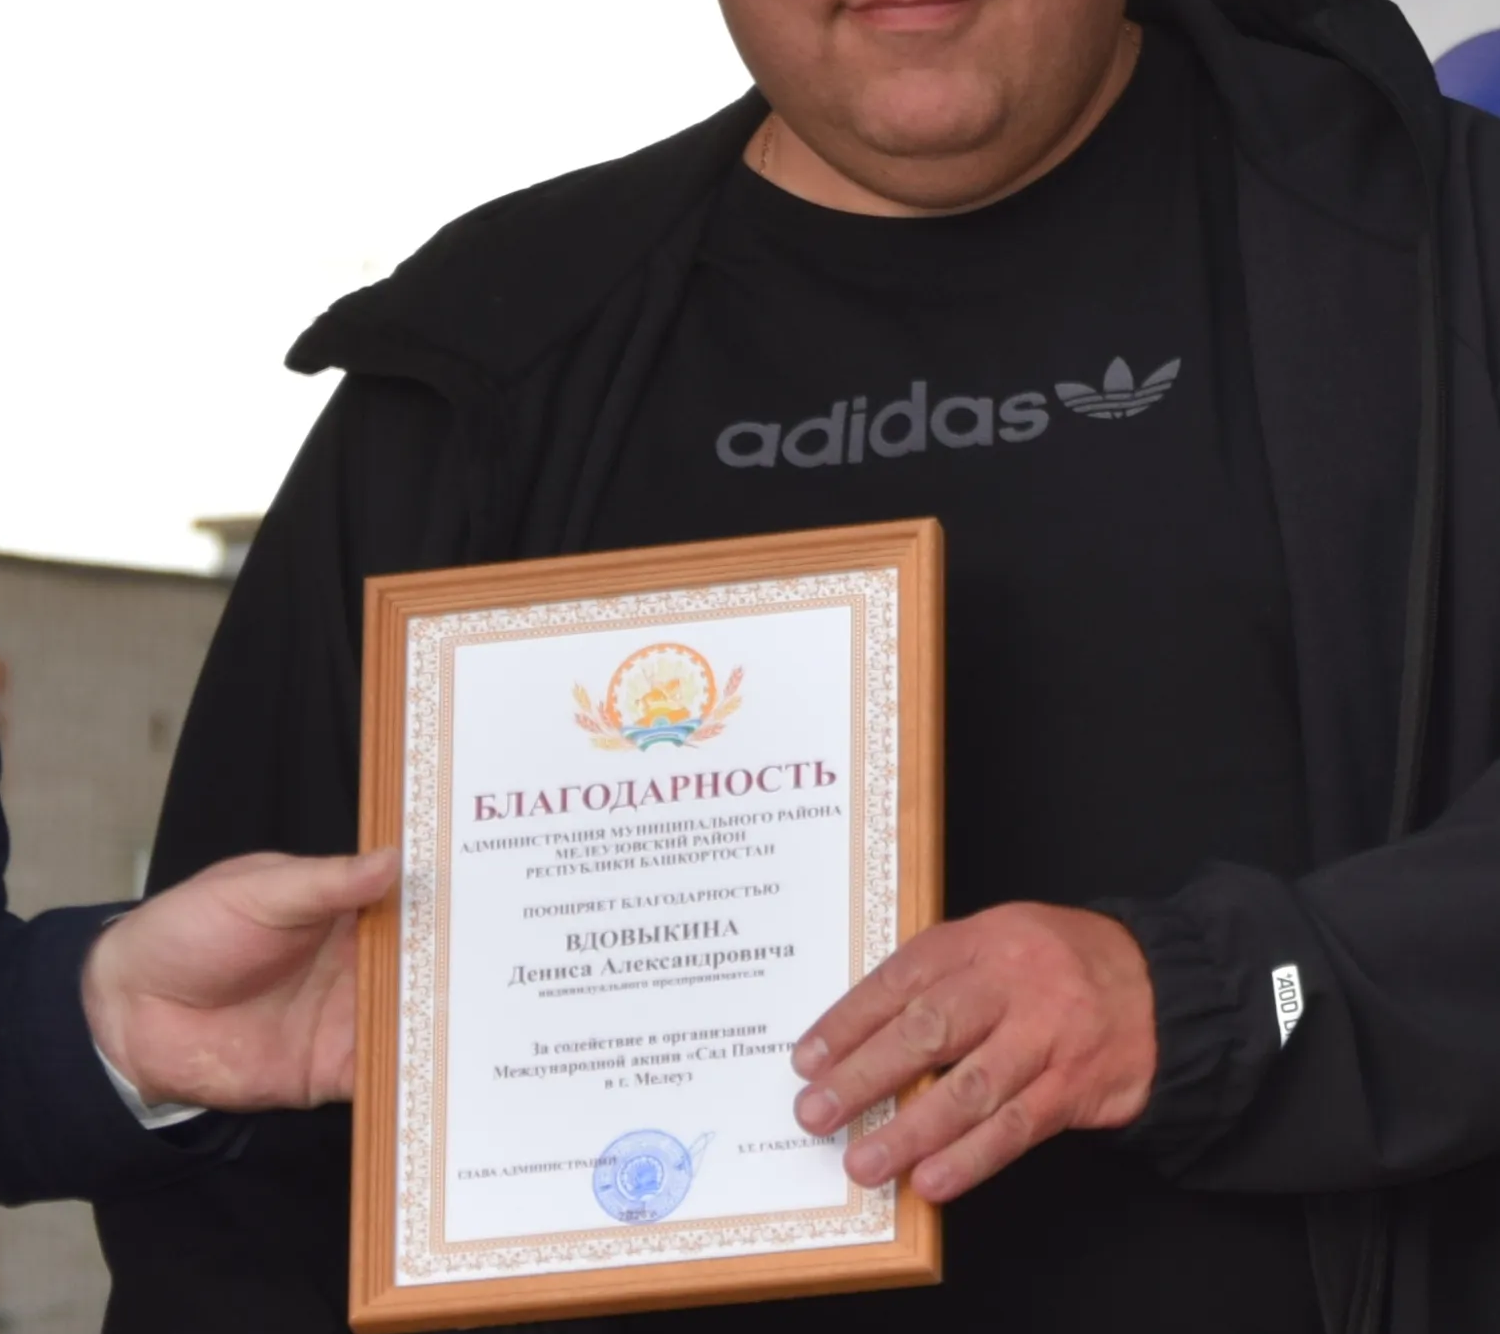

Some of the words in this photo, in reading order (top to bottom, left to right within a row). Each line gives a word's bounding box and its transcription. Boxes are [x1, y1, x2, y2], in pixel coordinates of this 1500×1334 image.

[715, 380, 1050, 468] adidas
[472, 760, 837, 822] БЛАГОДАРНОСТЬ
[460, 829, 606, 854] АДМИНИСТРАЦИЯ
[610, 812, 773, 839] МУНИЦИПАЛЬНОГО
[777, 805, 842, 822] РАЙОНА
[555, 833, 687, 860] МЕЛЕУЗОВСКИЙ
[692, 830, 746, 847] РАЙОН
[526, 858, 635, 880] РЕСПУБЛИКИ
[639, 844, 776, 868] БАШКОРТОСТАН
[522, 899, 617, 919] ПООЩРЯЕТ
[621, 883, 780, 909] БЛАГОДАРНОСТЬЮ
[565, 919, 740, 954] ВДОВЫКИНА
[507, 963, 593, 987] Дениса
[600, 943, 796, 976] Александровича
[538, 980, 648, 998] индивидуального
[652, 969, 765, 989] предпринимателя
[532, 1041, 549, 1056] За
[553, 1035, 644, 1054] содействие
[647, 1034, 658, 1046] в
[662, 1024, 767, 1046] организации
[493, 1055, 626, 1080] Международной
[630, 1051, 682, 1067] акции
[635, 1072, 693, 1087] Мелеуз
[458, 1168, 497, 1180] ГЛАВА
